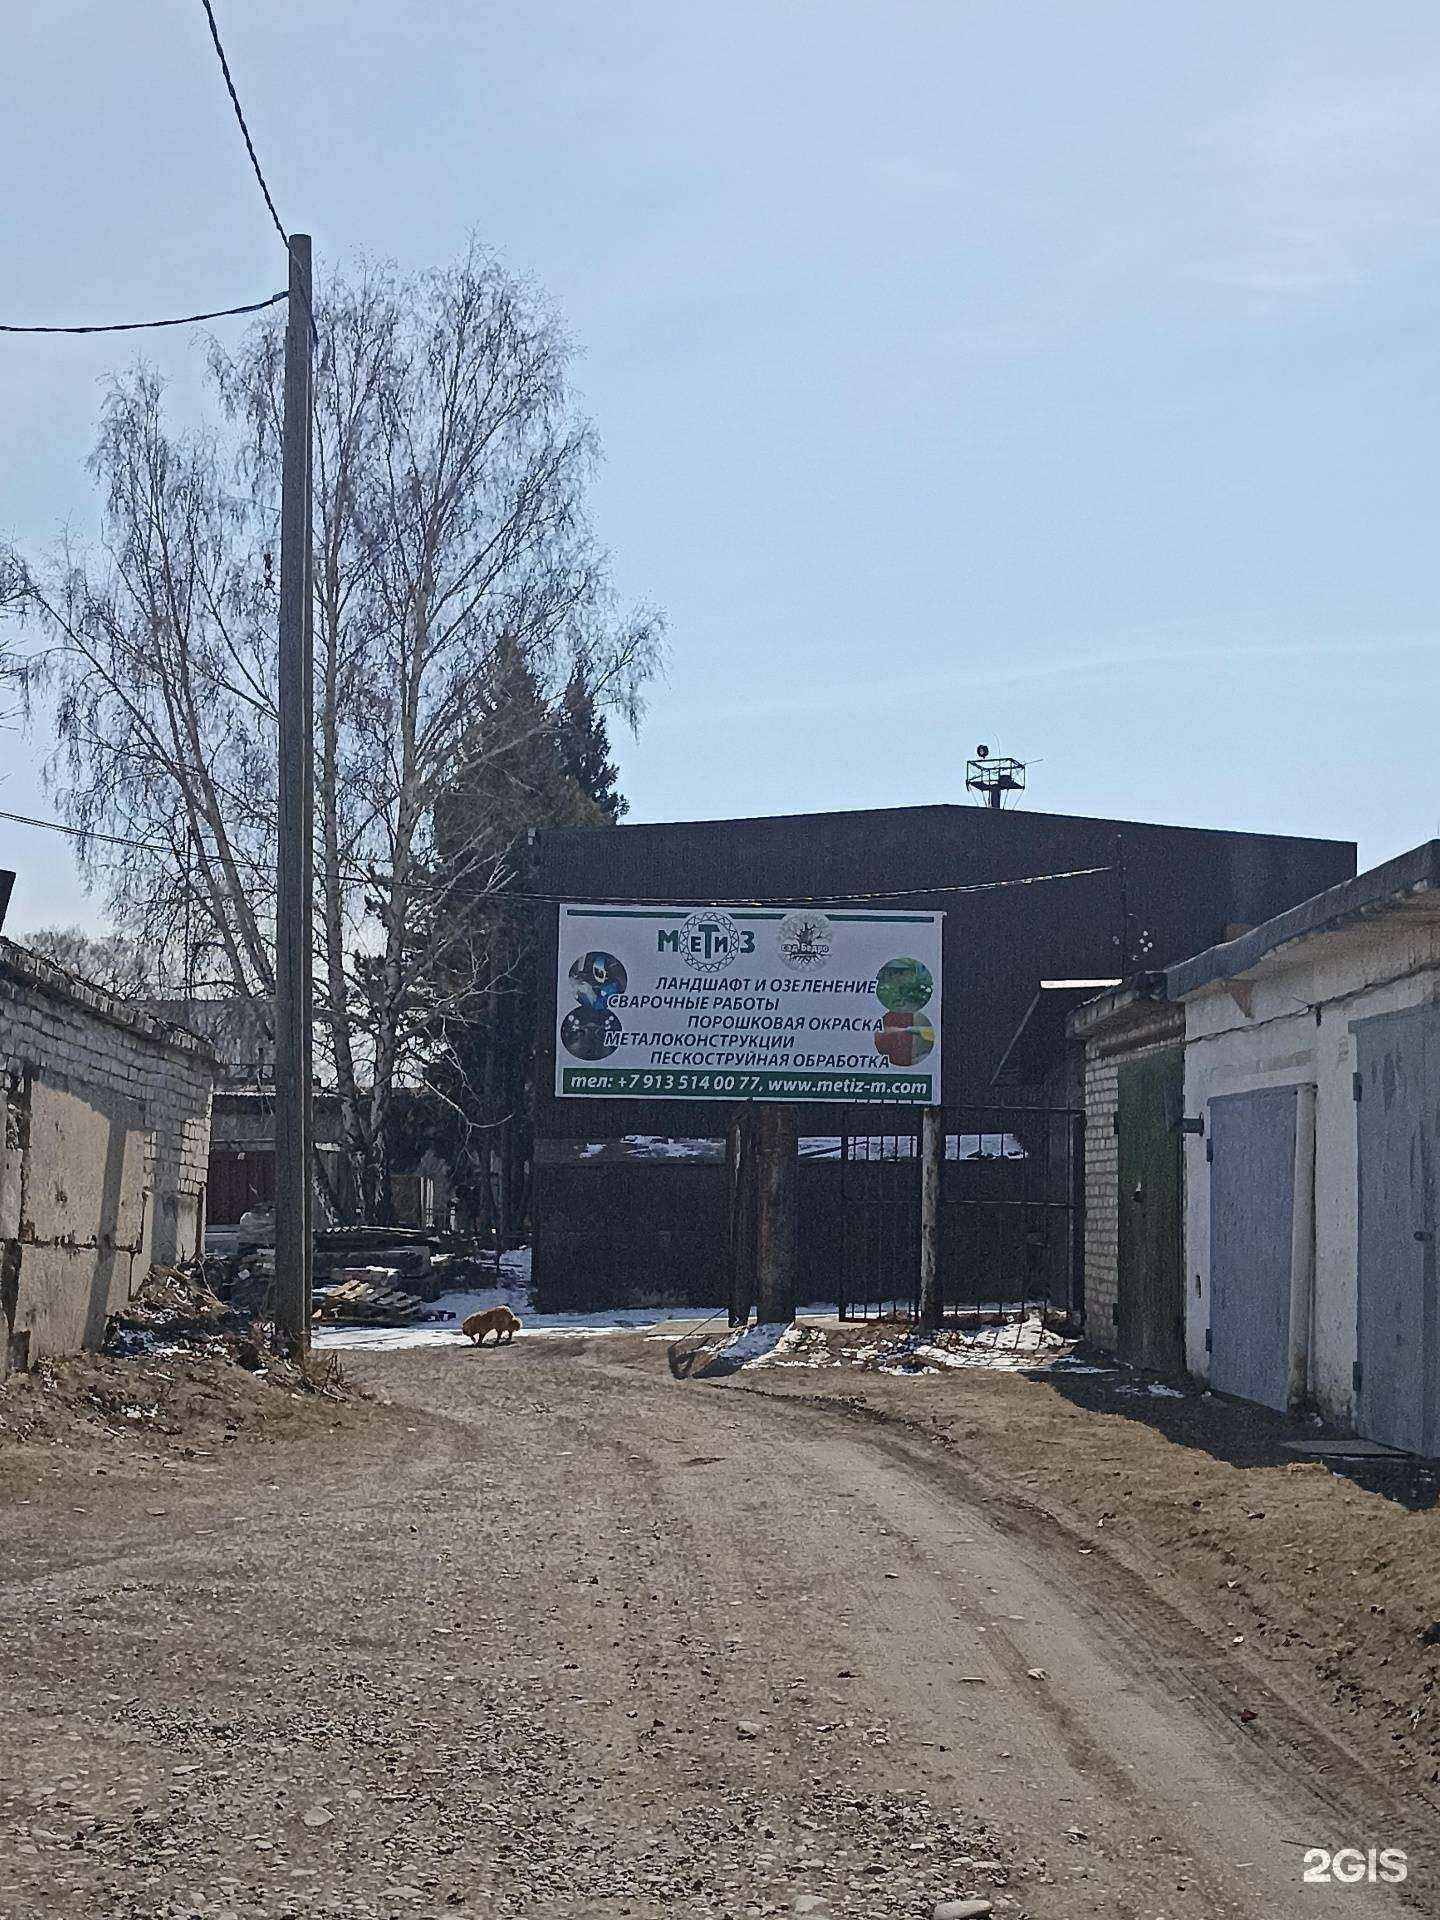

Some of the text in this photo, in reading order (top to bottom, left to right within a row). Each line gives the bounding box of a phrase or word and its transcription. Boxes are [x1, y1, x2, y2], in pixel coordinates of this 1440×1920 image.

[656, 976, 877, 993] ЛАНДШАФТ И ОЗЕЛЕНЕНИЕ
[608, 995, 780, 1010] СВАРОЧНЫЕ РАБОТЫ
[688, 1015, 883, 1031] ПОРОШКОВАЯ ОКРАСКА
[604, 1032, 795, 1050] МЕТАЛОКОНСТРУКЦИИ
[650, 1051, 890, 1068] ПЕСКОСТРУЙНАЯ ОБРАБОТКА
[571, 1074, 928, 1094] тел: +7 913 514 00 77, www.metiz-m.com
